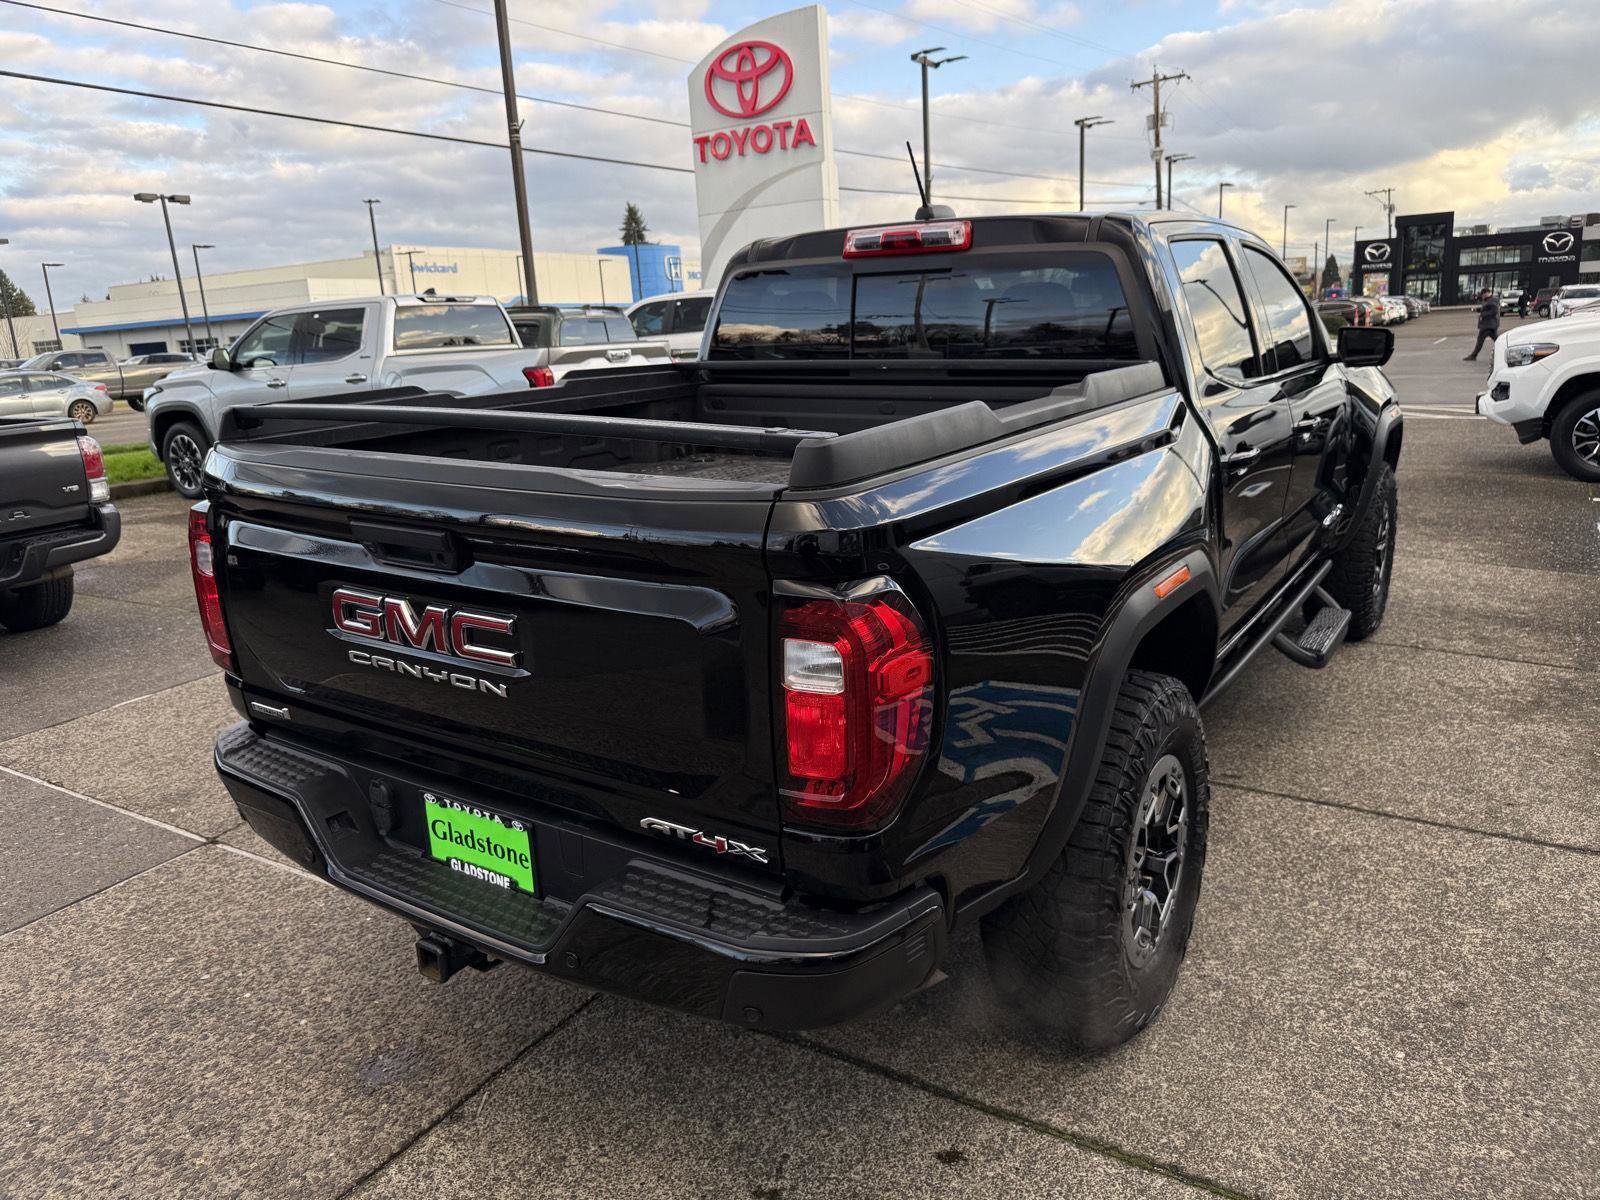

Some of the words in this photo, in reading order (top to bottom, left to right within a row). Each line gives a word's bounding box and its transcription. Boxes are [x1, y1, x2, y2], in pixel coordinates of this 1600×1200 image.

[693, 118, 817, 164] TOYOTA
[332, 586, 525, 668] GMC
[348, 650, 509, 698] CANYON
[443, 798, 504, 825] TOYOTA
[431, 819, 530, 870] Gladstone
[639, 816, 769, 864] AT4X
[450, 858, 511, 890] GLADSTONE
